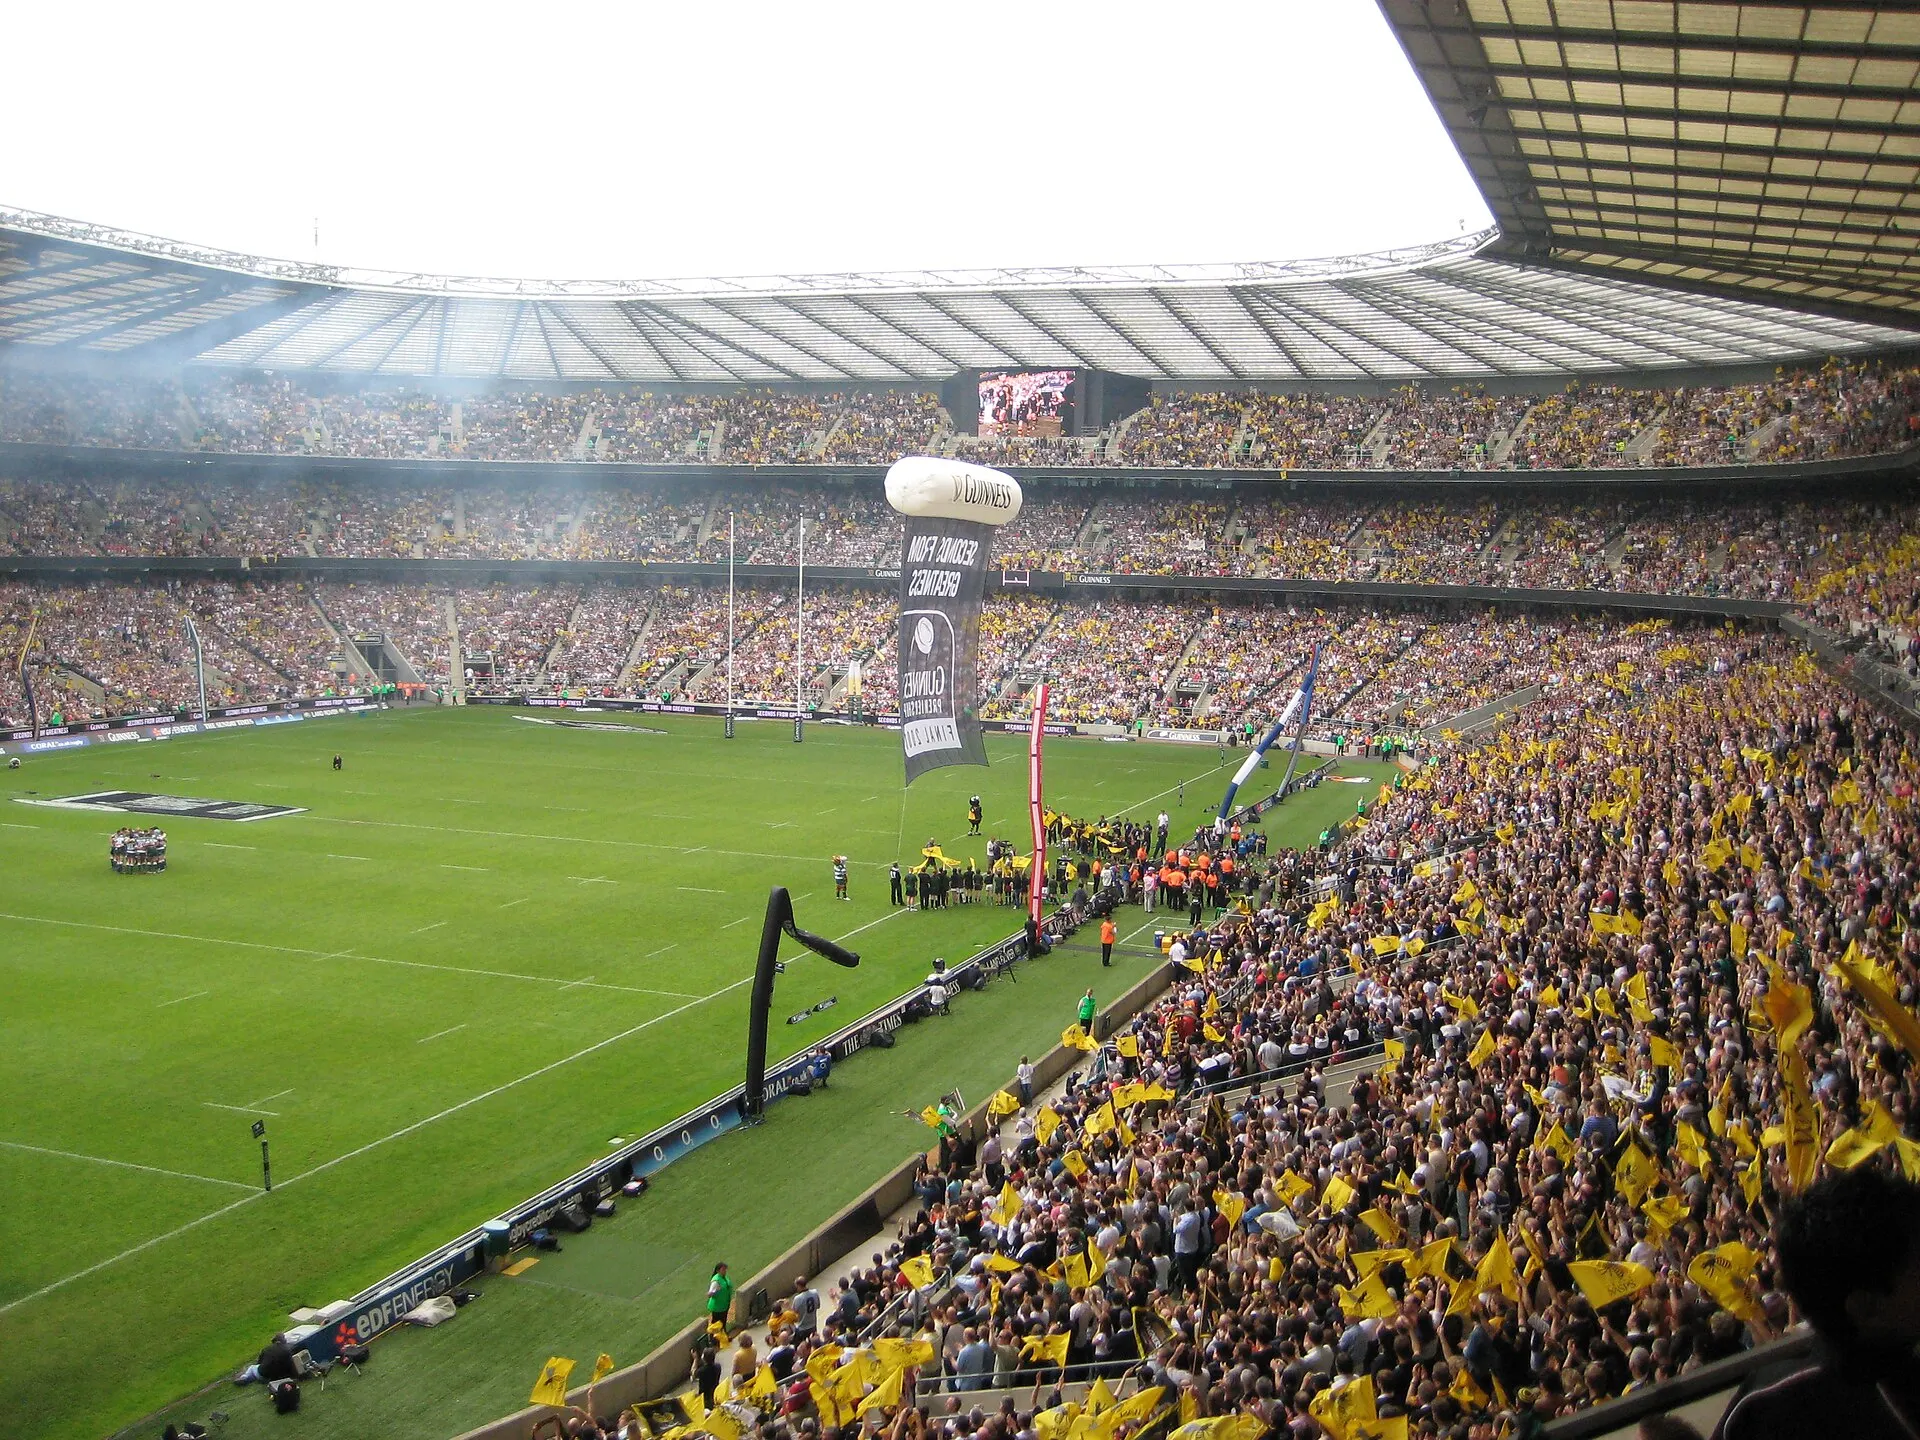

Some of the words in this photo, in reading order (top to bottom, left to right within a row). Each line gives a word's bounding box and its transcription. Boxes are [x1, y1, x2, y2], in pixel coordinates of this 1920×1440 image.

[965, 474, 1011, 509] GUINNESS
[1079, 574, 1111, 584] GUINNESS
[90, 722, 110, 731] GUINNESS
[1004, 723, 1026, 731] SECONDS
[13, 731, 33, 740] SECONDS
[46, 727, 69, 736] GREATNESS
[107, 730, 140, 743] GUINNESS
[1168, 731, 1200, 741] GUINNESS
[30, 741, 56, 750] CORAL
[842, 1034, 861, 1057] THE
[878, 1012, 903, 1033] TIMES
